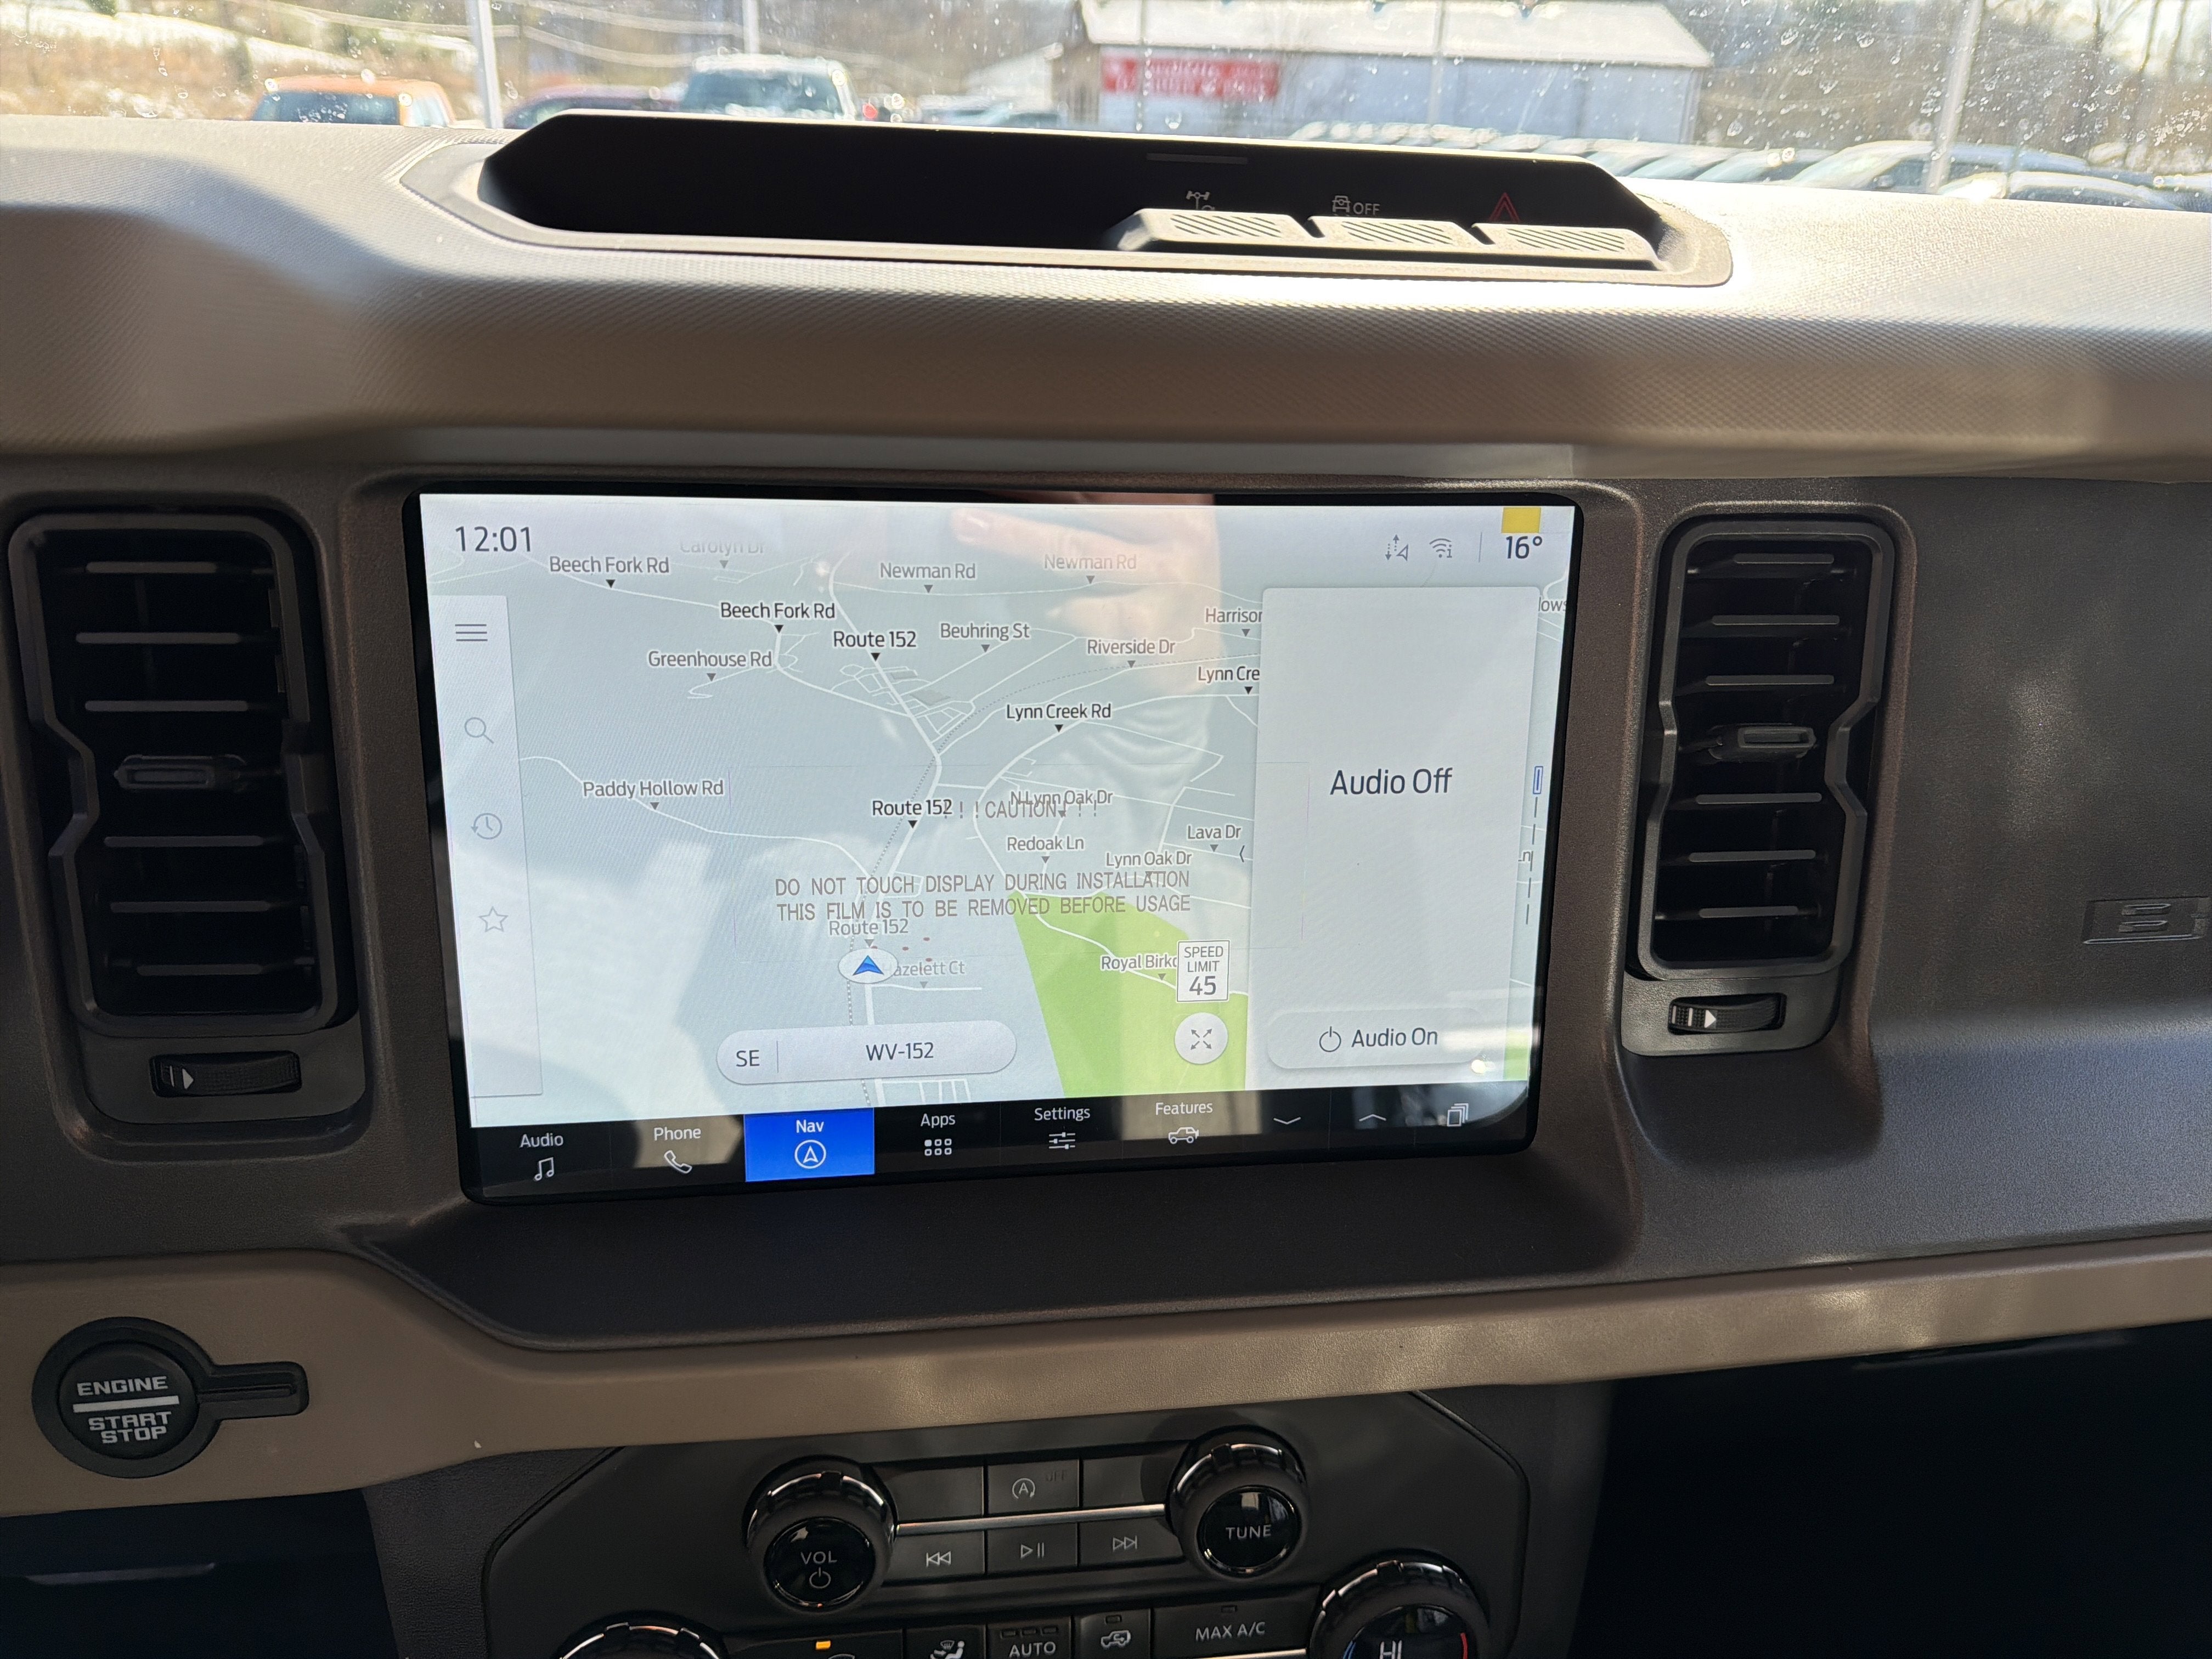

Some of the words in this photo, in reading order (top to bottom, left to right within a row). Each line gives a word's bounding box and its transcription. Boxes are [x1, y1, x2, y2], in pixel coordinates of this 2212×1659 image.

[1353, 202, 1380, 215] OFF
[455, 525, 532, 552] 12:01
[549, 556, 601, 573] Beech
[605, 557, 643, 573] Fork
[646, 557, 670, 574] Rd
[879, 563, 951, 579] Newman
[955, 563, 976, 579] Rd
[1043, 554, 1113, 571] Newman
[1116, 554, 1137, 570] Rd
[721, 602, 771, 618] Beech
[774, 602, 810, 619] Fork
[814, 603, 836, 619] Rd
[833, 631, 885, 647] Route
[889, 631, 917, 647] 152
[940, 623, 1009, 642] Beuhring
[1013, 623, 1030, 639] St
[1087, 639, 1155, 654] Riverside
[1159, 639, 1176, 654] Dr
[648, 651, 747, 667] Greenhouse
[750, 651, 772, 667] Rd
[1198, 666, 1233, 684] Lynn
[1006, 704, 1042, 721] Lynn
[1046, 703, 1088, 719] Creek
[1091, 704, 1111, 718] Rd
[583, 781, 636, 799] Paddy
[640, 780, 698, 796] Hollow
[702, 780, 724, 795] Rd
[1330, 769, 1405, 795] Audio
[1413, 768, 1453, 793] Off
[1064, 791, 1094, 804] Oak
[1097, 790, 1113, 804] Dr
[872, 800, 922, 816] Route
[926, 799, 952, 815] 152
[985, 800, 1057, 818] CAUTION
[1187, 826, 1221, 839] Lava
[1224, 825, 1241, 838] Dr
[1007, 837, 1063, 850] Redoak
[1066, 836, 1084, 850] Ln
[1106, 852, 1141, 867] Lynn
[1144, 851, 1173, 865] Oak
[1176, 851, 1192, 864] Dr
[775, 878, 800, 895] DO
[811, 878, 846, 895] NOT
[856, 876, 915, 894] TOUCH
[926, 874, 995, 892] DISPLAY
[1005, 873, 1067, 890] DURING
[1076, 871, 1189, 889] INSTALLATION
[777, 903, 815, 921] THIS
[827, 902, 865, 919] FILM
[876, 901, 891, 918] IS
[902, 901, 924, 917] TO
[935, 900, 957, 917] BE
[968, 898, 1050, 916] REMOVED
[1060, 896, 1126, 914] BEFORE
[1136, 894, 1191, 912] USAGE
[829, 920, 878, 935] Route
[882, 918, 909, 934] 152
[1184, 946, 1223, 958] SPEED
[893, 961, 946, 976] azelett
[949, 961, 965, 974] Ct
[1102, 955, 1141, 971] Royal
[1187, 961, 1220, 973] LIMIT
[1189, 975, 1216, 996] 45
[1351, 1028, 1407, 1048] Audio
[1412, 1028, 1438, 1046] On
[735, 1049, 760, 1067] SE
[866, 1042, 934, 1061] WV-152
[1034, 1105, 1091, 1122] Settings
[1155, 1101, 1213, 1116] Features
[795, 1119, 824, 1133] Nav
[921, 1113, 956, 1128] Apps
[520, 1133, 563, 1149] Audio
[653, 1126, 701, 1141] Phone
[77, 1376, 168, 1396] ENGINE
[88, 1411, 172, 1431] START
[101, 1426, 167, 1444] STOP
[1226, 1525, 1272, 1539] TUNE
[800, 1551, 837, 1564] VOL
[1195, 1624, 1232, 1642] MAX
[1237, 1621, 1266, 1638] A/C
[1009, 1641, 1056, 1658] AUTO
